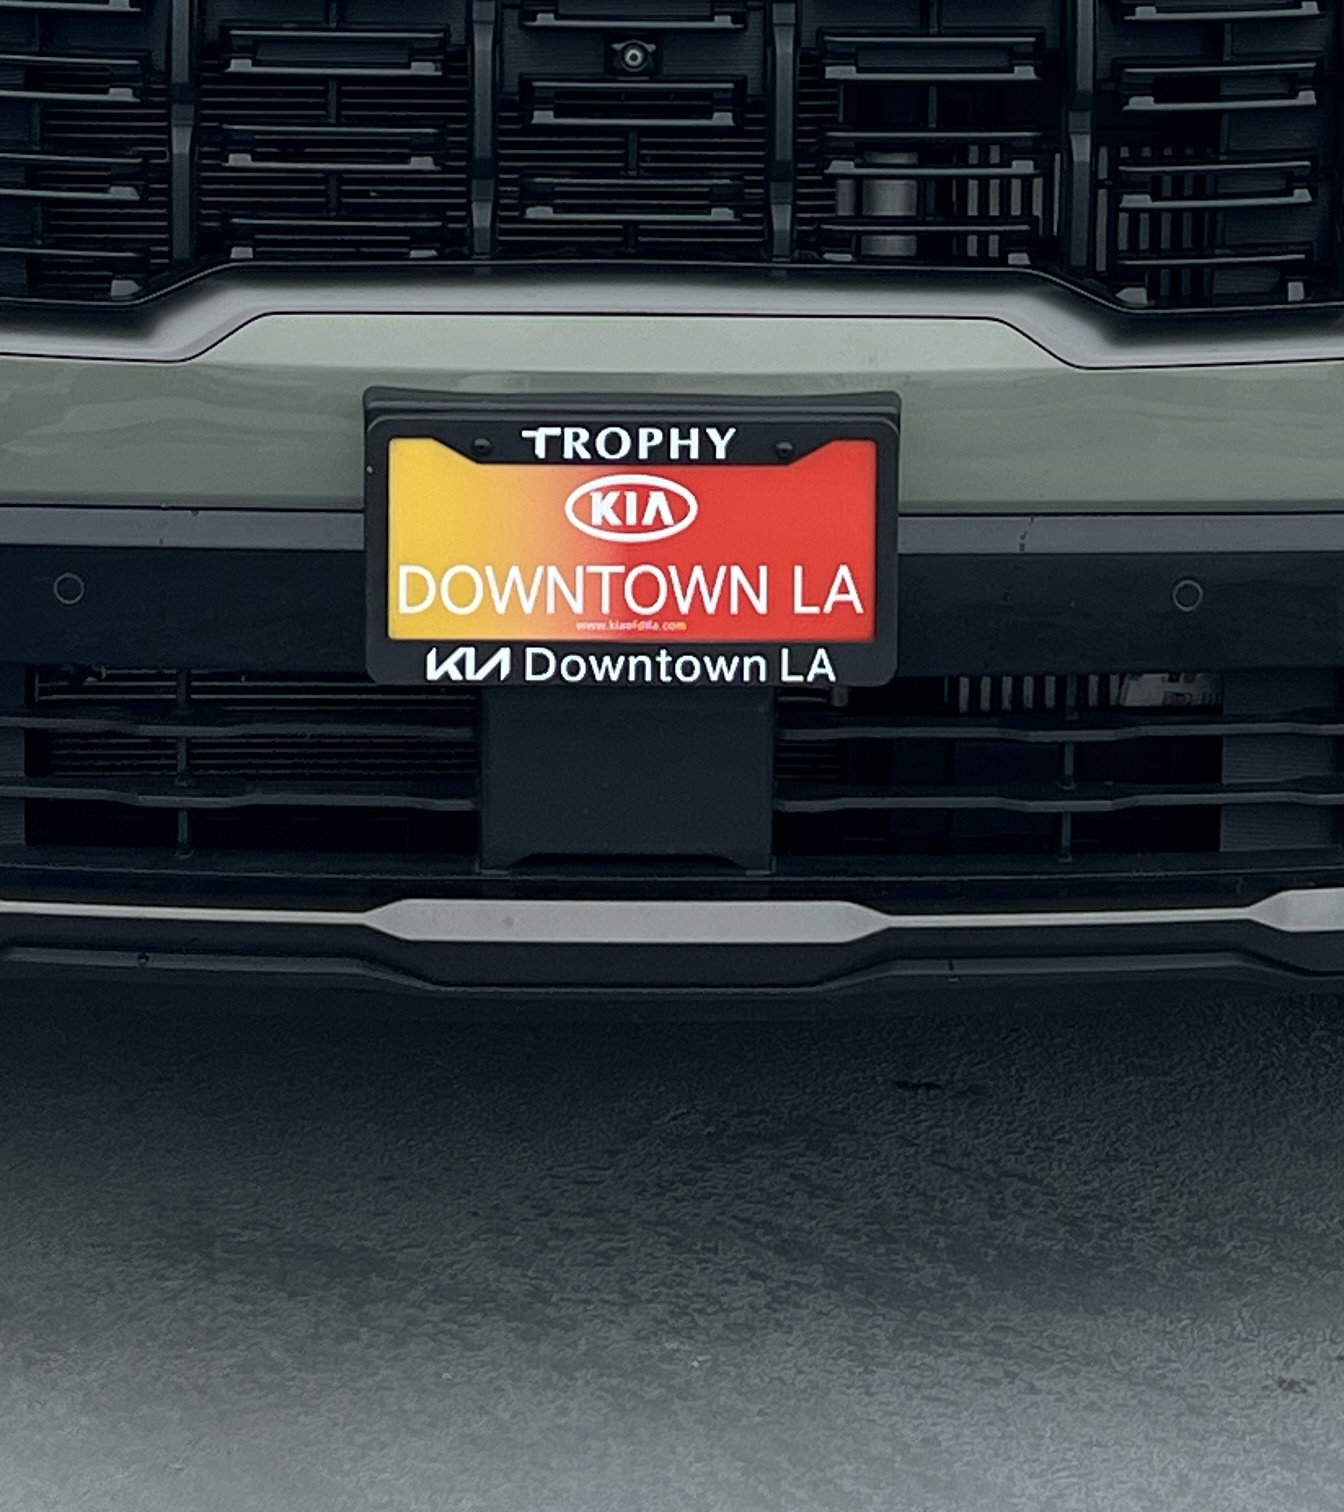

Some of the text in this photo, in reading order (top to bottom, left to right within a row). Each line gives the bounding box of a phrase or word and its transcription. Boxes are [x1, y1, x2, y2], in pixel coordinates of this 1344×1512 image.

[522, 426, 737, 459] TROPHY
[589, 490, 675, 526] KIA
[398, 564, 864, 615] DOWNTOWN LA
[426, 646, 837, 682] KIA Downtown LA
